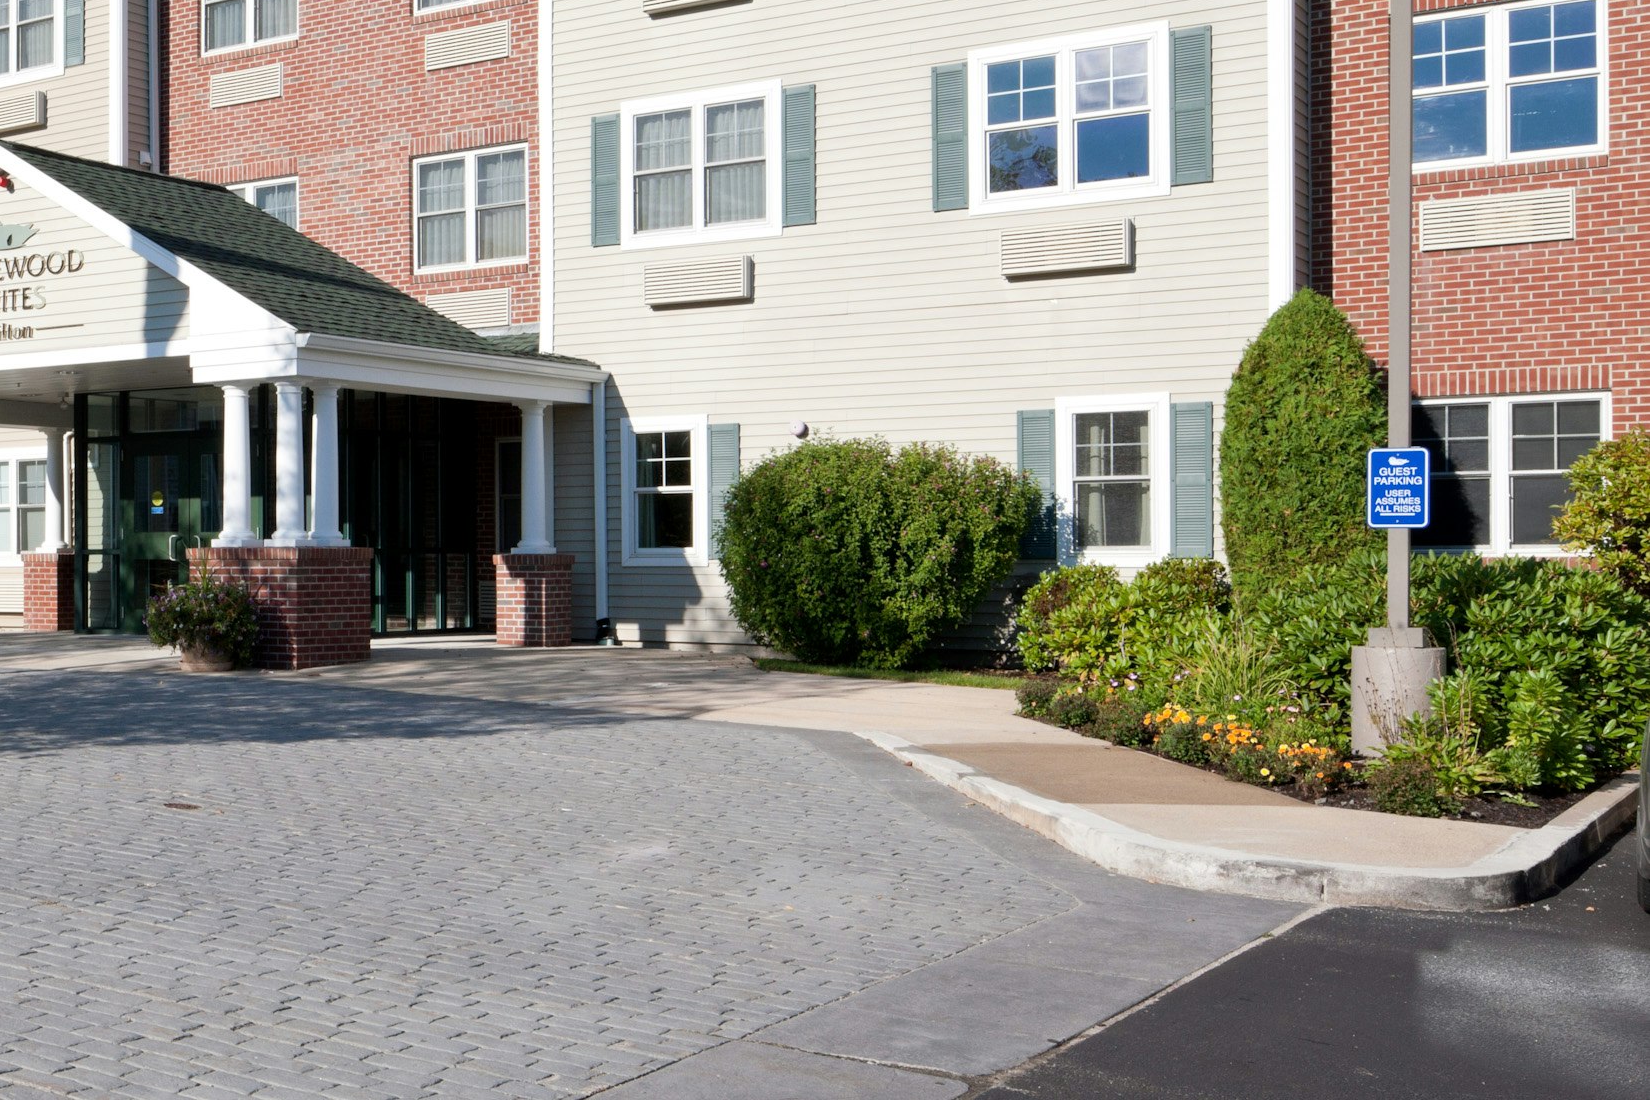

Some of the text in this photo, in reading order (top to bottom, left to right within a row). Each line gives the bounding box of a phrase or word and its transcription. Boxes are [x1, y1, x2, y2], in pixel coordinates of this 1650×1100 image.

[1378, 467, 1417, 476] GUEST
[1373, 476, 1423, 486] PARKING
[1385, 489, 1411, 497] USER
[1375, 497, 1421, 505] ASSUMES
[1375, 505, 1422, 513] ALL RISKS
